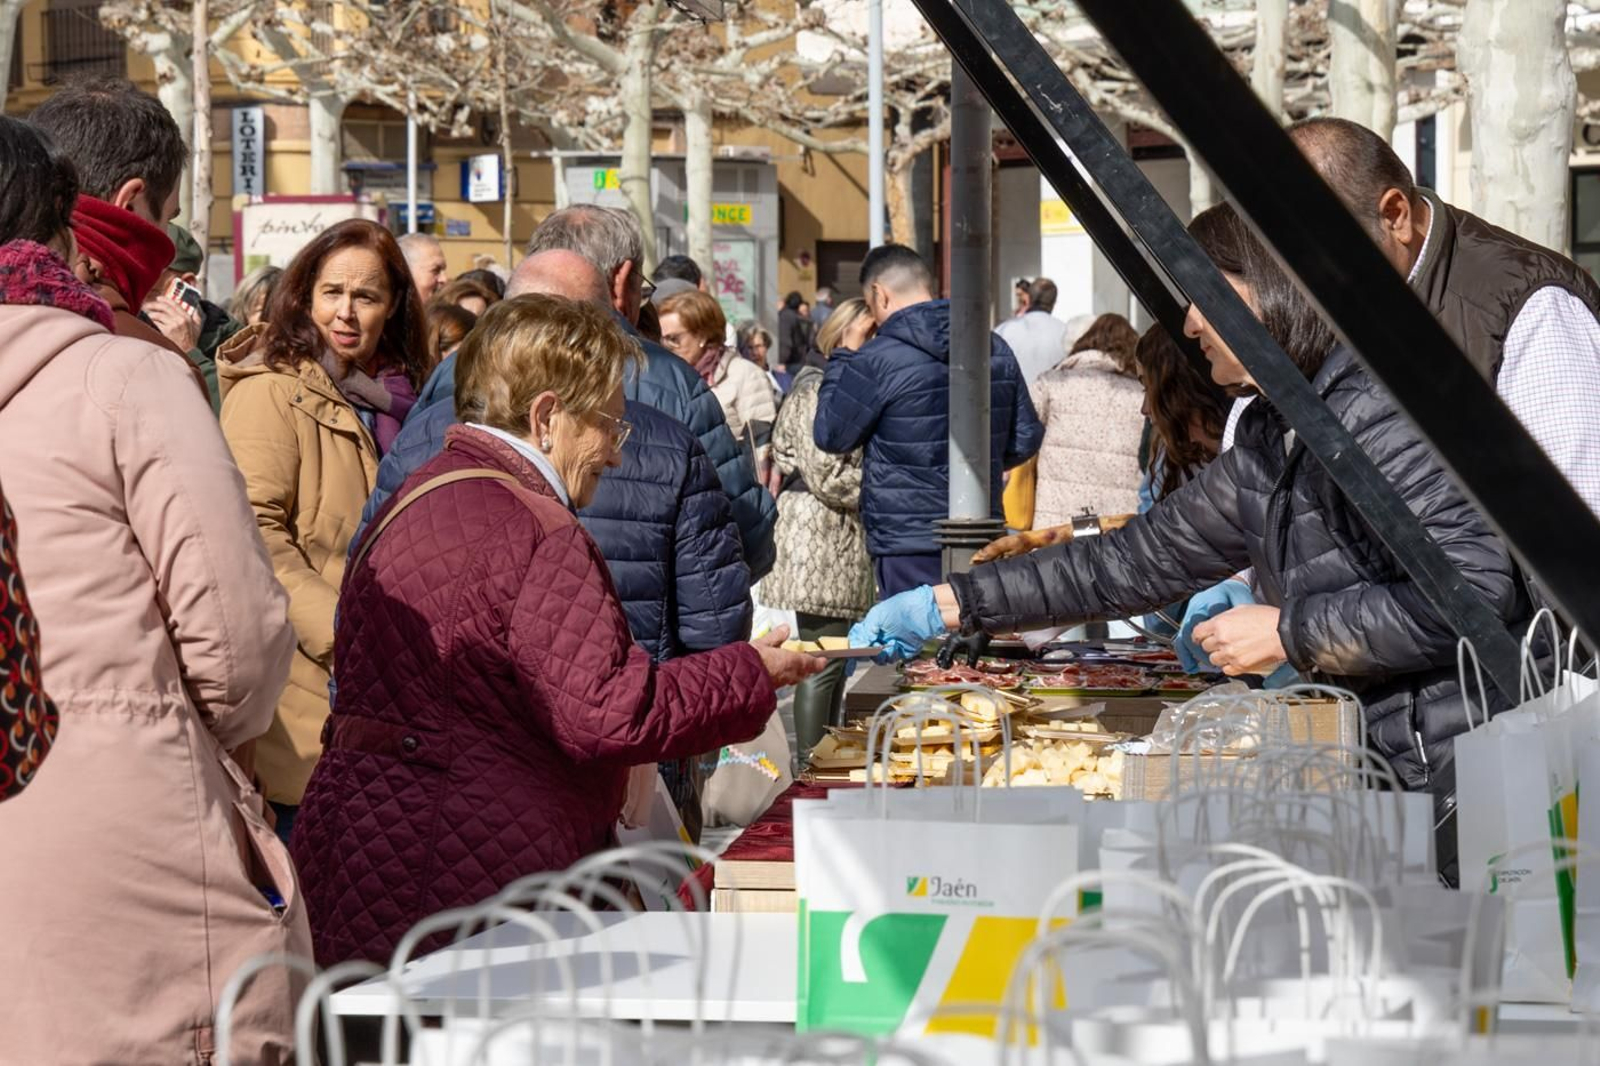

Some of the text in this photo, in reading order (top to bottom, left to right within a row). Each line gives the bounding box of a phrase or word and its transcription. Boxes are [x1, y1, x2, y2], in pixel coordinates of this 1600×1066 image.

[240, 111, 256, 195] LOTERI
[712, 207, 747, 221] NCE
[930, 876, 978, 898] Jaén
